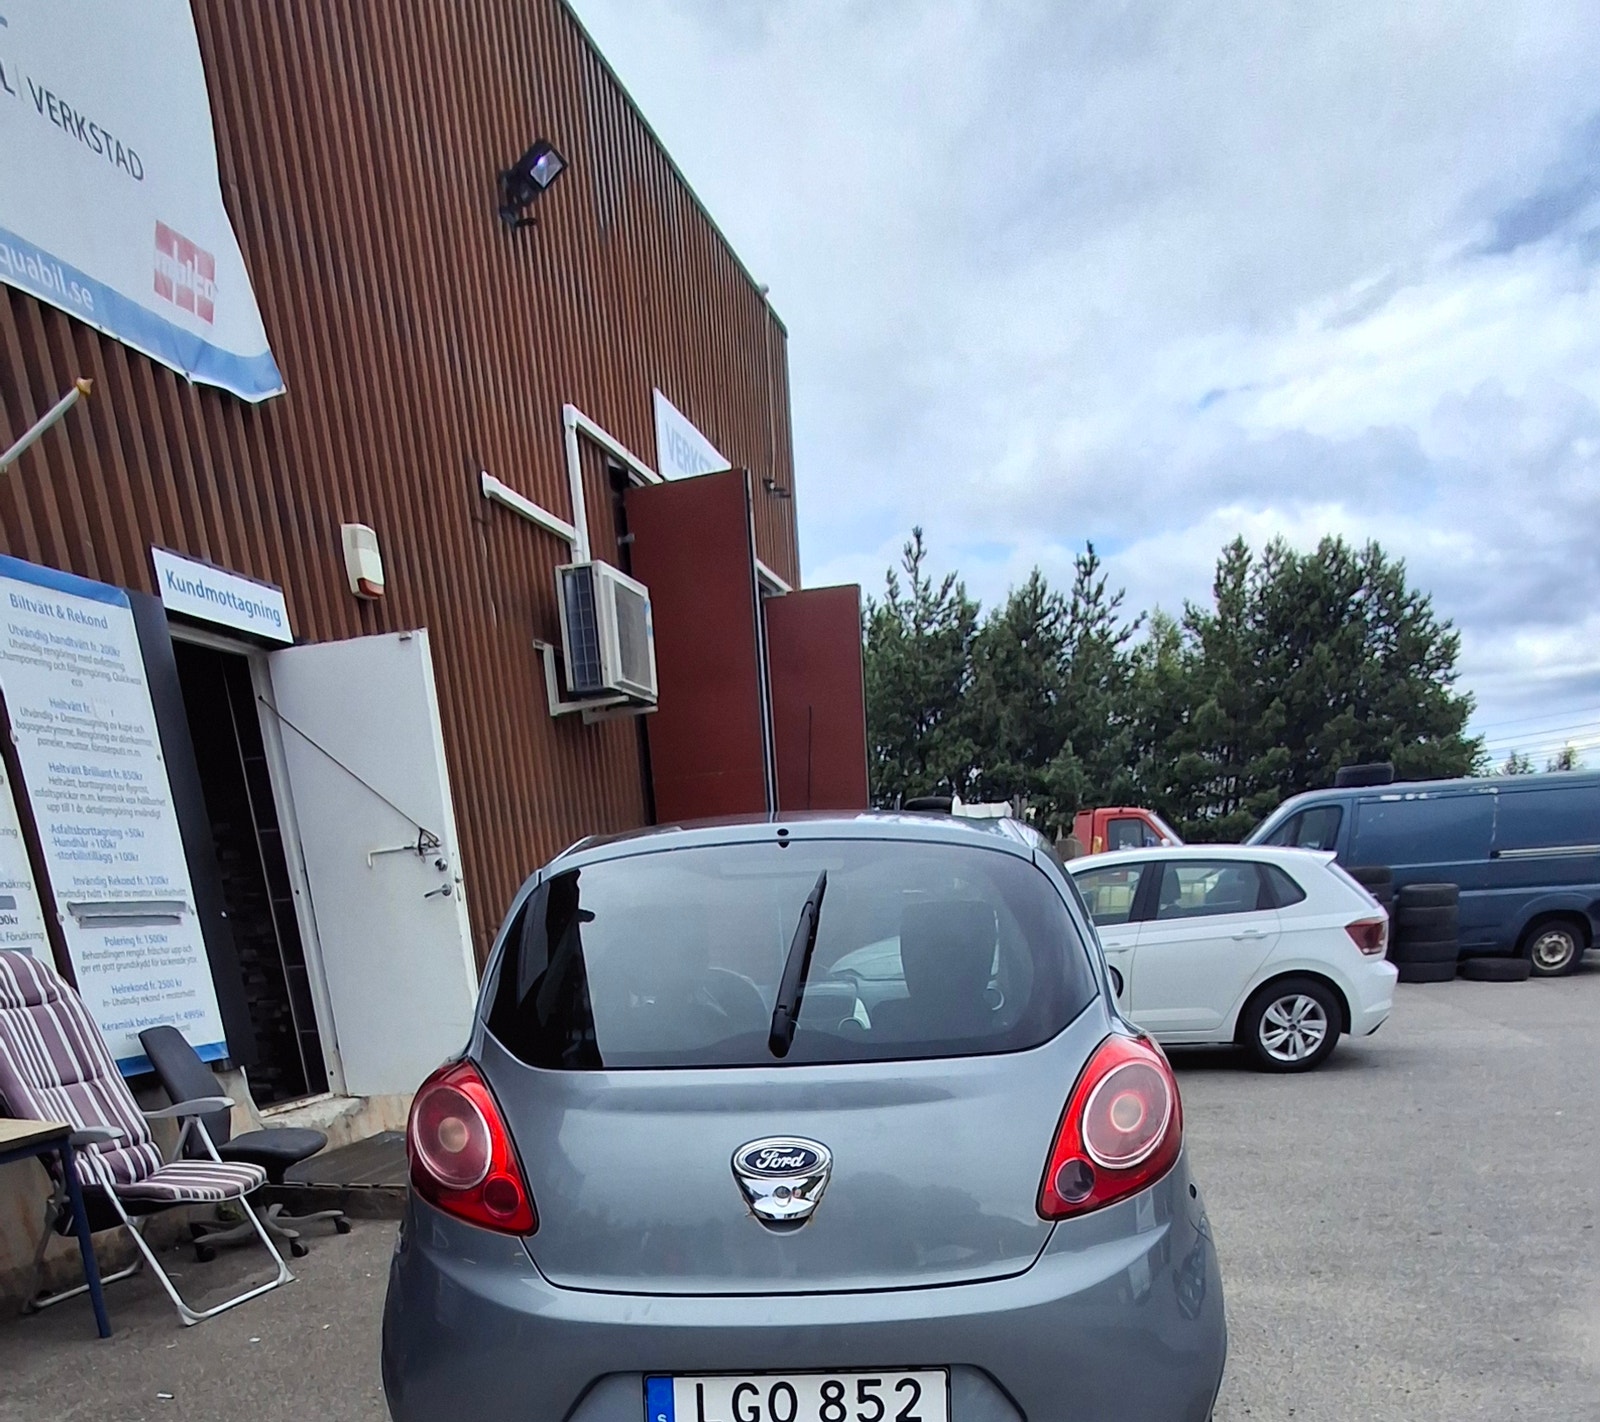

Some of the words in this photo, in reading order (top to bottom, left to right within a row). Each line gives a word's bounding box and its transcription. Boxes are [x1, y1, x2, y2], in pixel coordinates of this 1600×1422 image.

[26, 76, 144, 181] VERKSTAD
[165, 568, 282, 628] Kundmottagning
[9, 592, 55, 618] Biltvätt
[56, 604, 66, 620] &
[66, 607, 109, 630] Rekond
[48, 762, 82, 775] Heltvätt
[107, 874, 136, 886] Rekond
[6, 930, 44, 942] Försäkring
[104, 935, 136, 947] Polering
[144, 933, 168, 944] 1500kr
[111, 980, 149, 995] Helrekond
[101, 1020, 135, 1032] Keramisk
[755, 1147, 806, 1169] Ford
